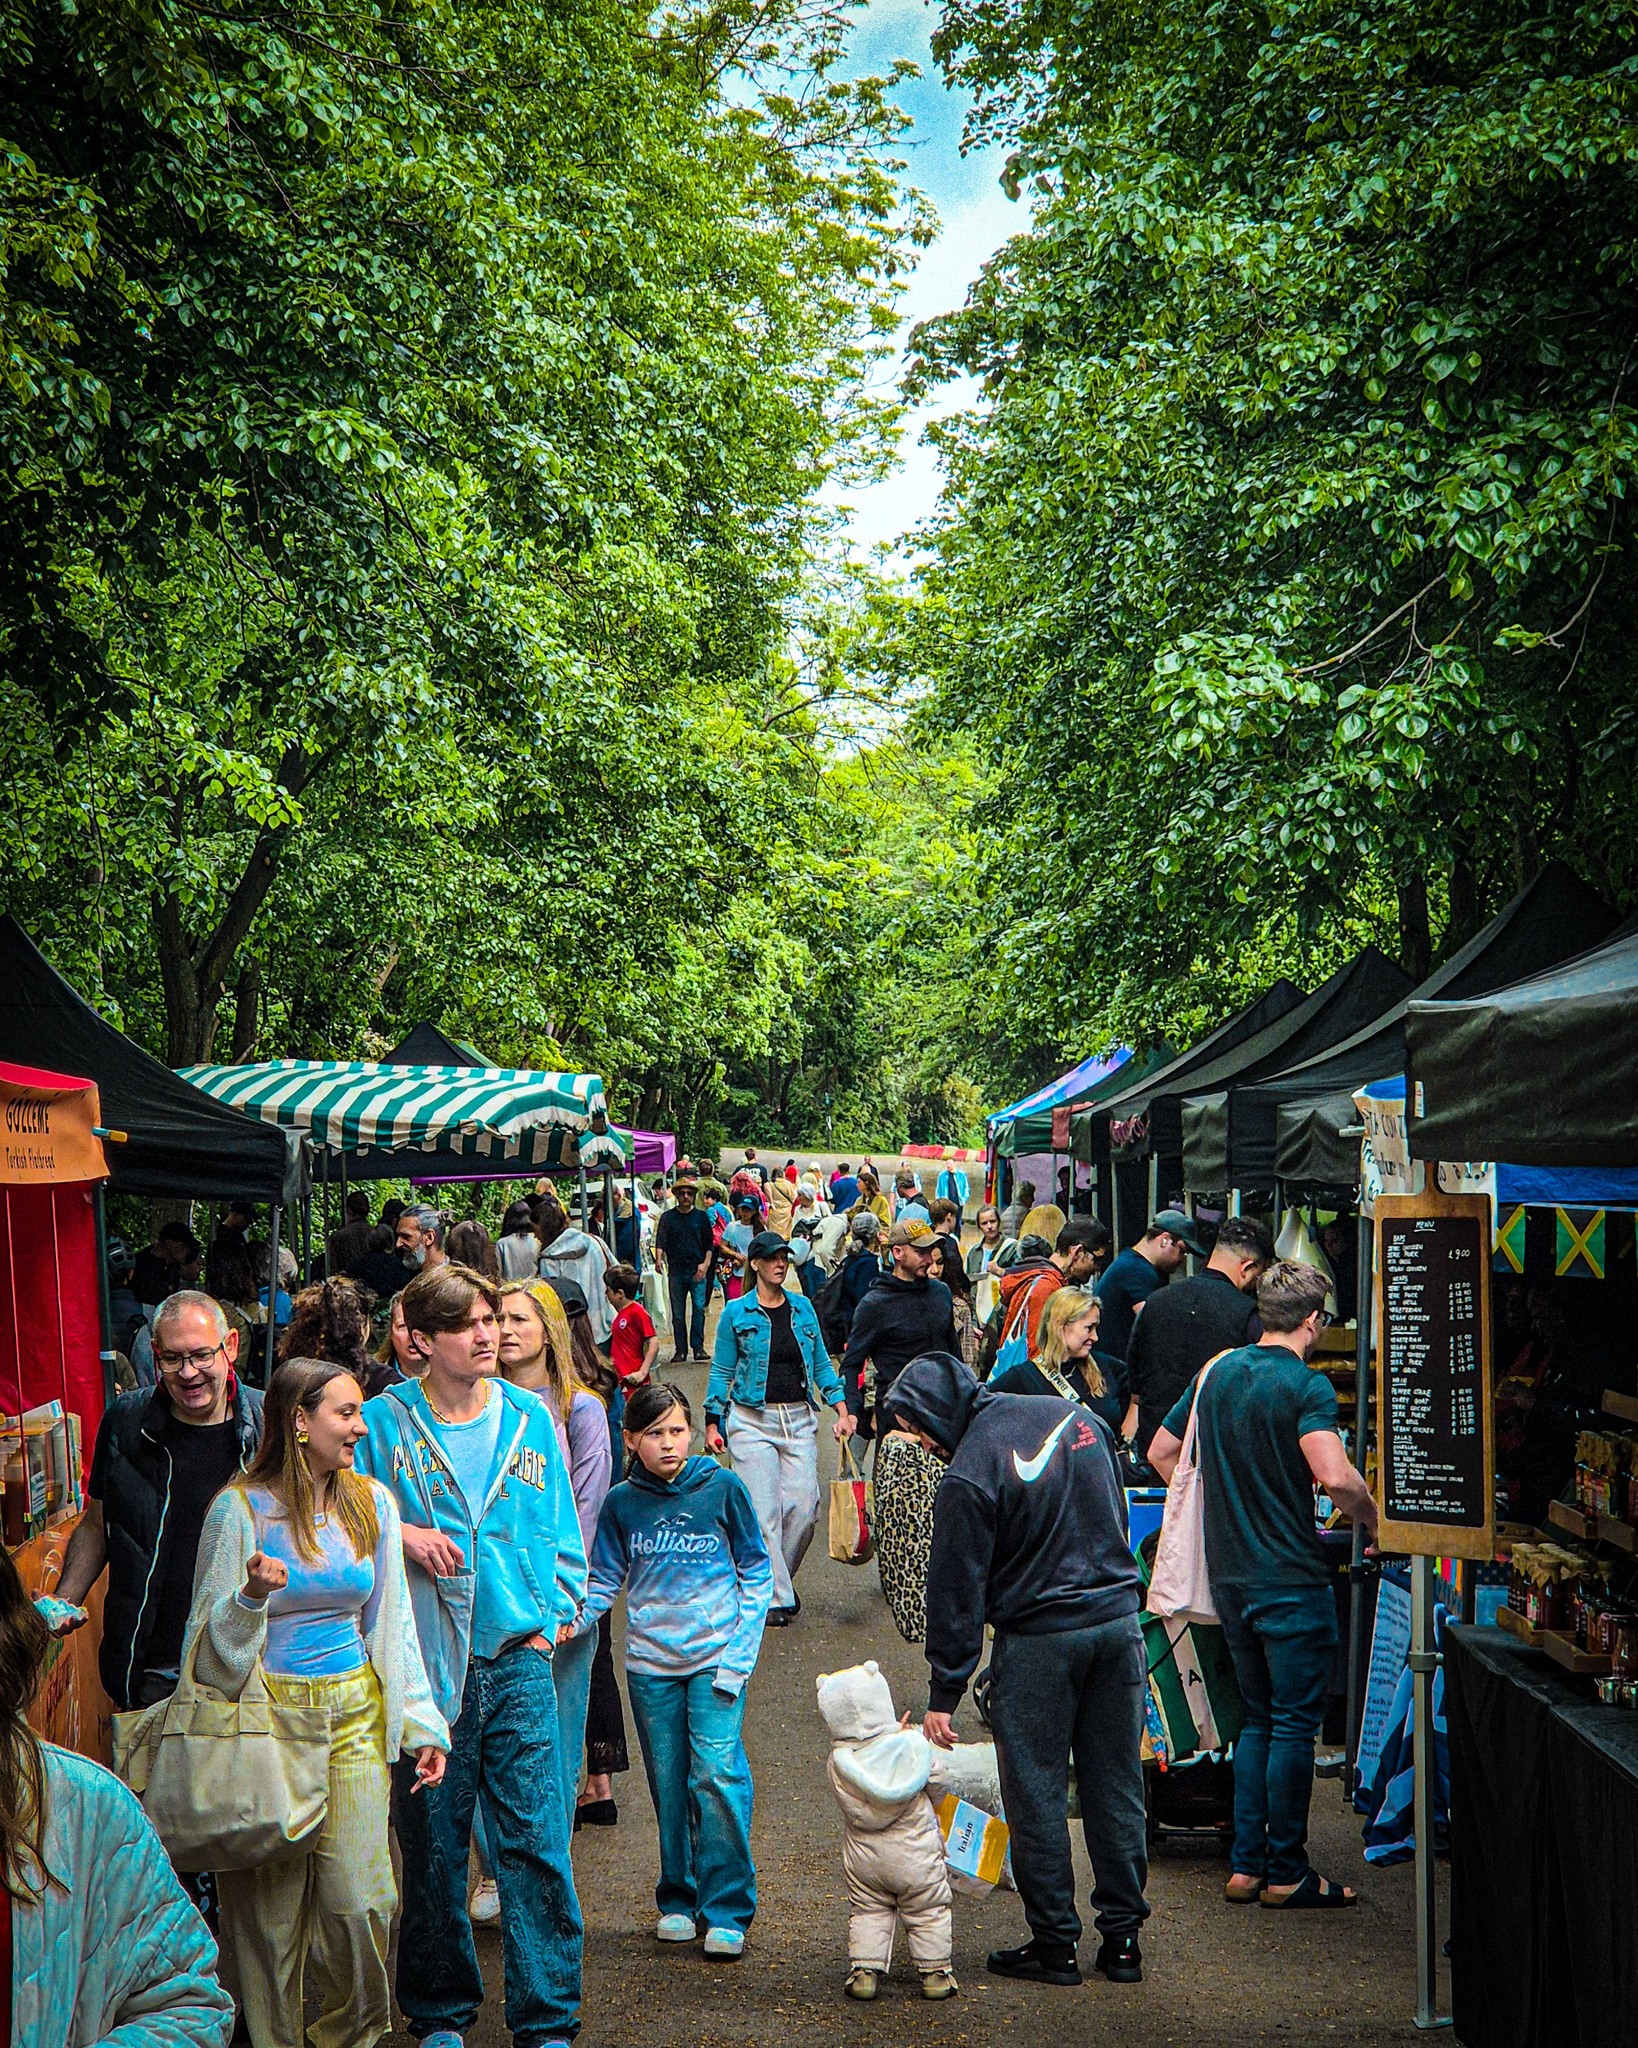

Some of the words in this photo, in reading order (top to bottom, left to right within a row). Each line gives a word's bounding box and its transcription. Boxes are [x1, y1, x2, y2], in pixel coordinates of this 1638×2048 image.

[1416, 1221, 1434, 1229] MENU
[1392, 1397, 1409, 1405] CURRY
[629, 1530, 719, 1558] Hollister
[957, 1822, 973, 1854] Italian
